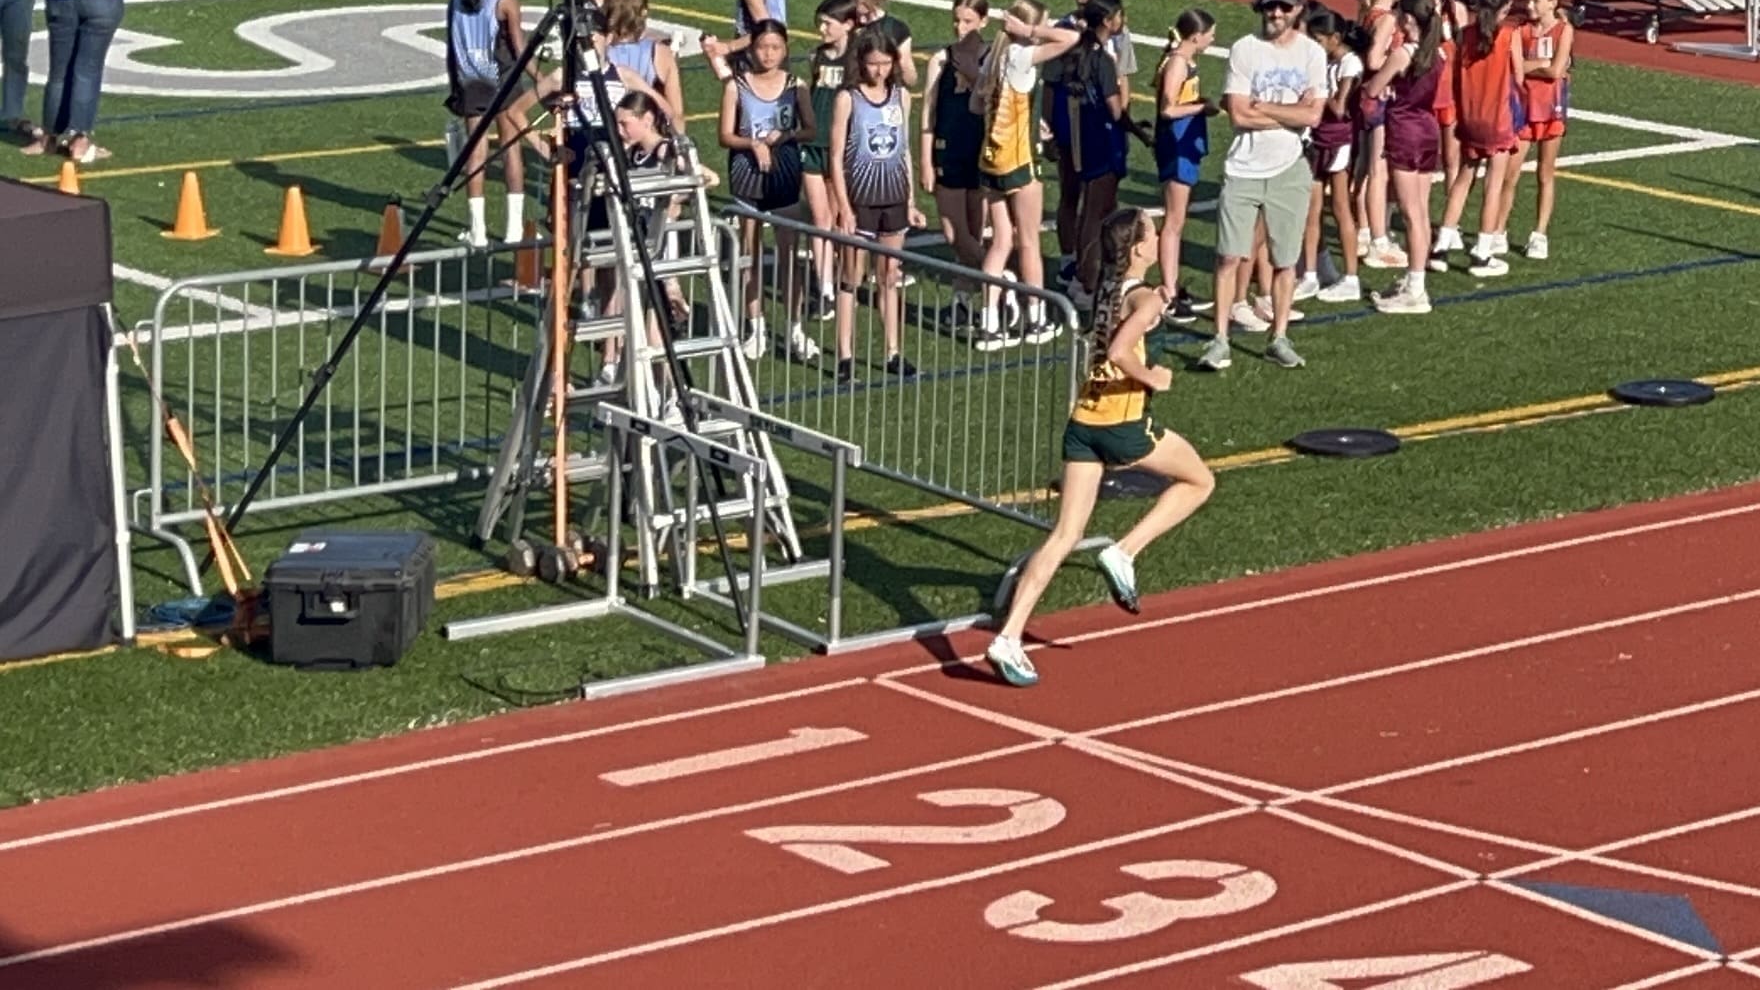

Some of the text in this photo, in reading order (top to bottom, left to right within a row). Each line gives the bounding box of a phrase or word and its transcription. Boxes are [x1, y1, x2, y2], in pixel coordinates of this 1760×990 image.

[598, 726, 868, 787] 1
[743, 788, 1067, 875] 2
[983, 859, 1278, 942] 3
